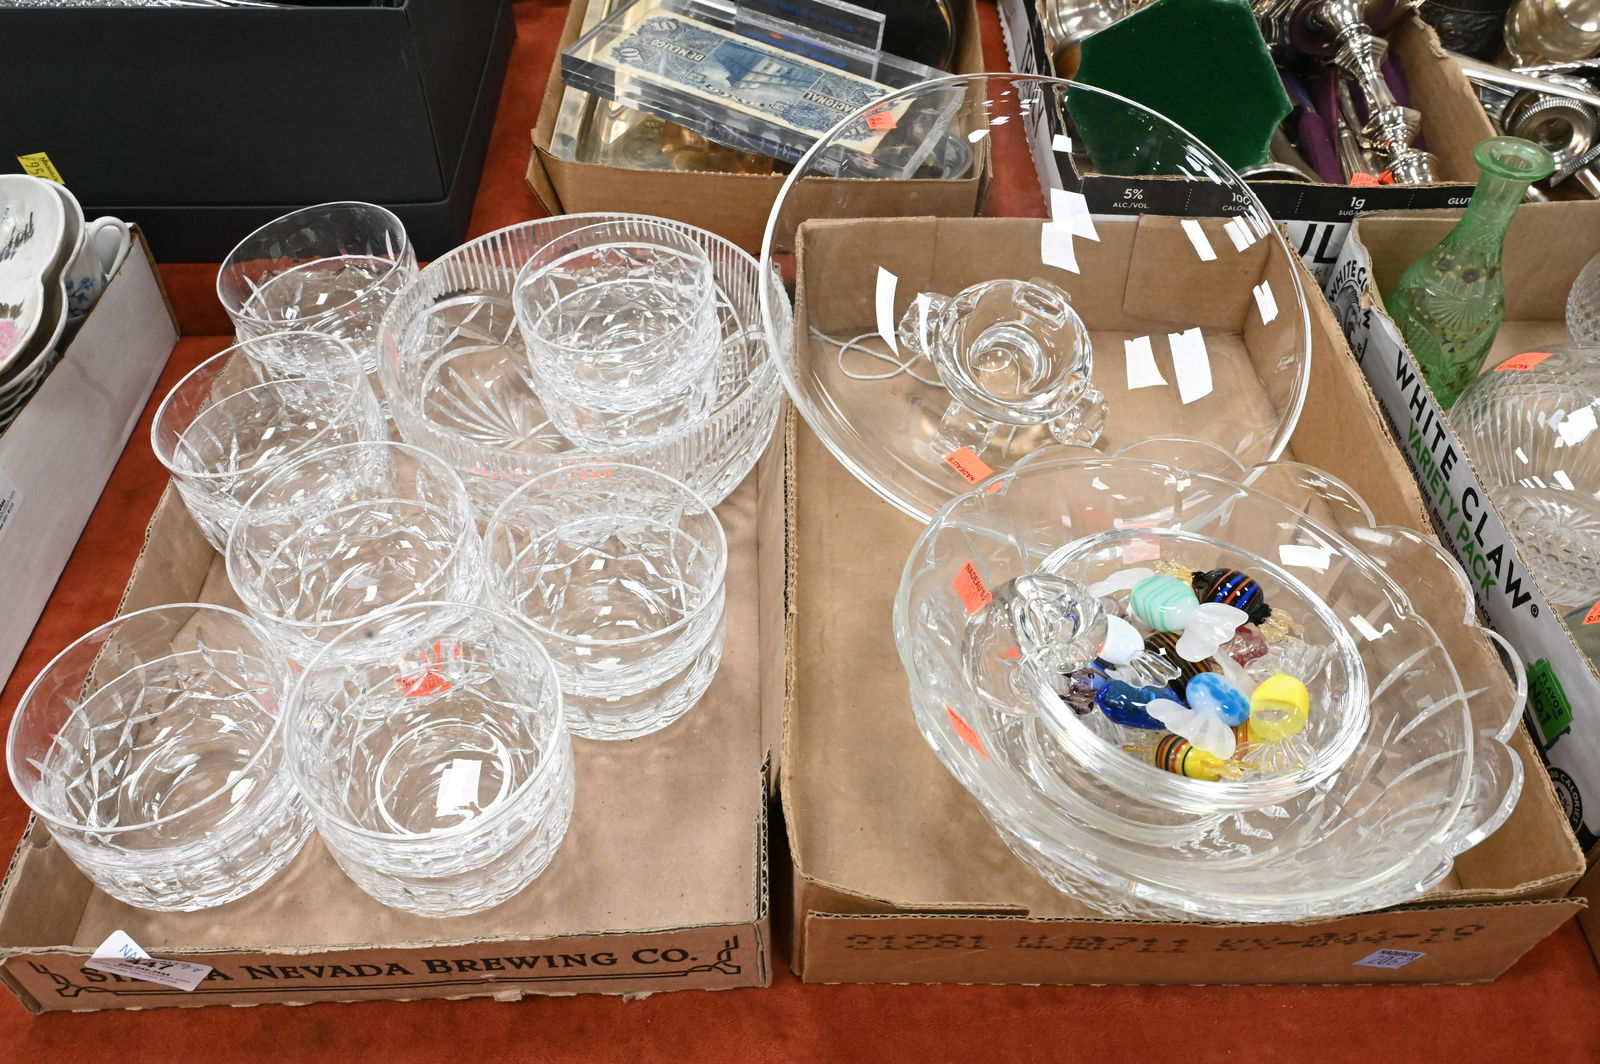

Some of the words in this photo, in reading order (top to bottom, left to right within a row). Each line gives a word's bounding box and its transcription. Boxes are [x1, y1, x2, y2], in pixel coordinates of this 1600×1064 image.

[651, 39, 688, 57] MEXICO
[1123, 188, 1144, 200] 5%
[1350, 196, 1366, 210] 1g
[1447, 197, 1473, 205] GLUT
[1394, 350, 1458, 483] WHITE
[948, 456, 976, 482] NADEAU'S
[1407, 418, 1459, 522] VARIETY
[1456, 521, 1497, 601] PACK
[1537, 671, 1564, 717] FLAVOR
[240, 963, 413, 980] NEVADA
[420, 951, 618, 975] BREWING
